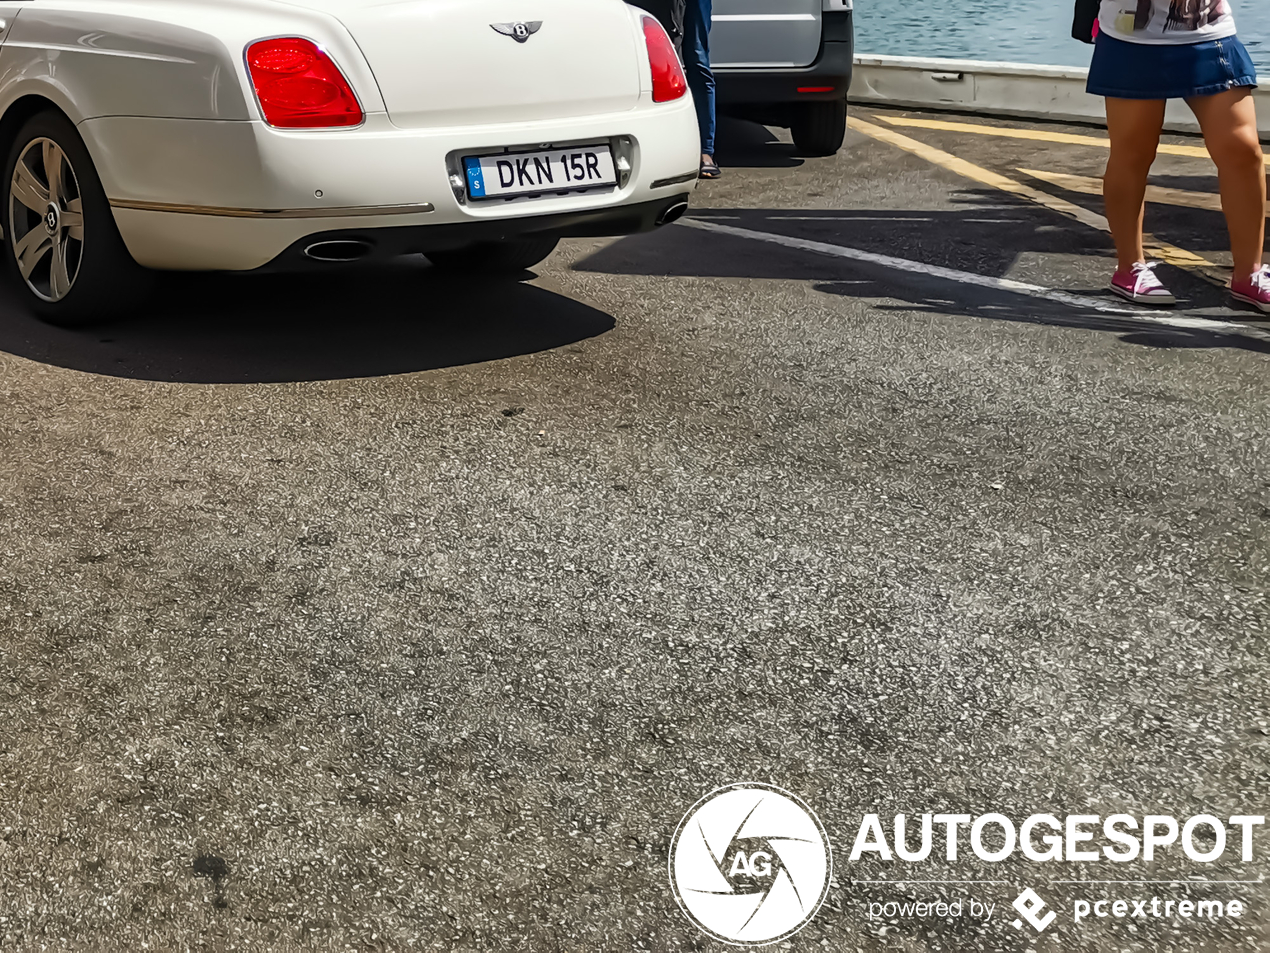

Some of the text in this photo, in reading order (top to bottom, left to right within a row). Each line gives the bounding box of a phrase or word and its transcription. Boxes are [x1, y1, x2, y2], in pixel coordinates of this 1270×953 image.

[496, 152, 602, 188] DKN 15R
[473, 180, 480, 189] S
